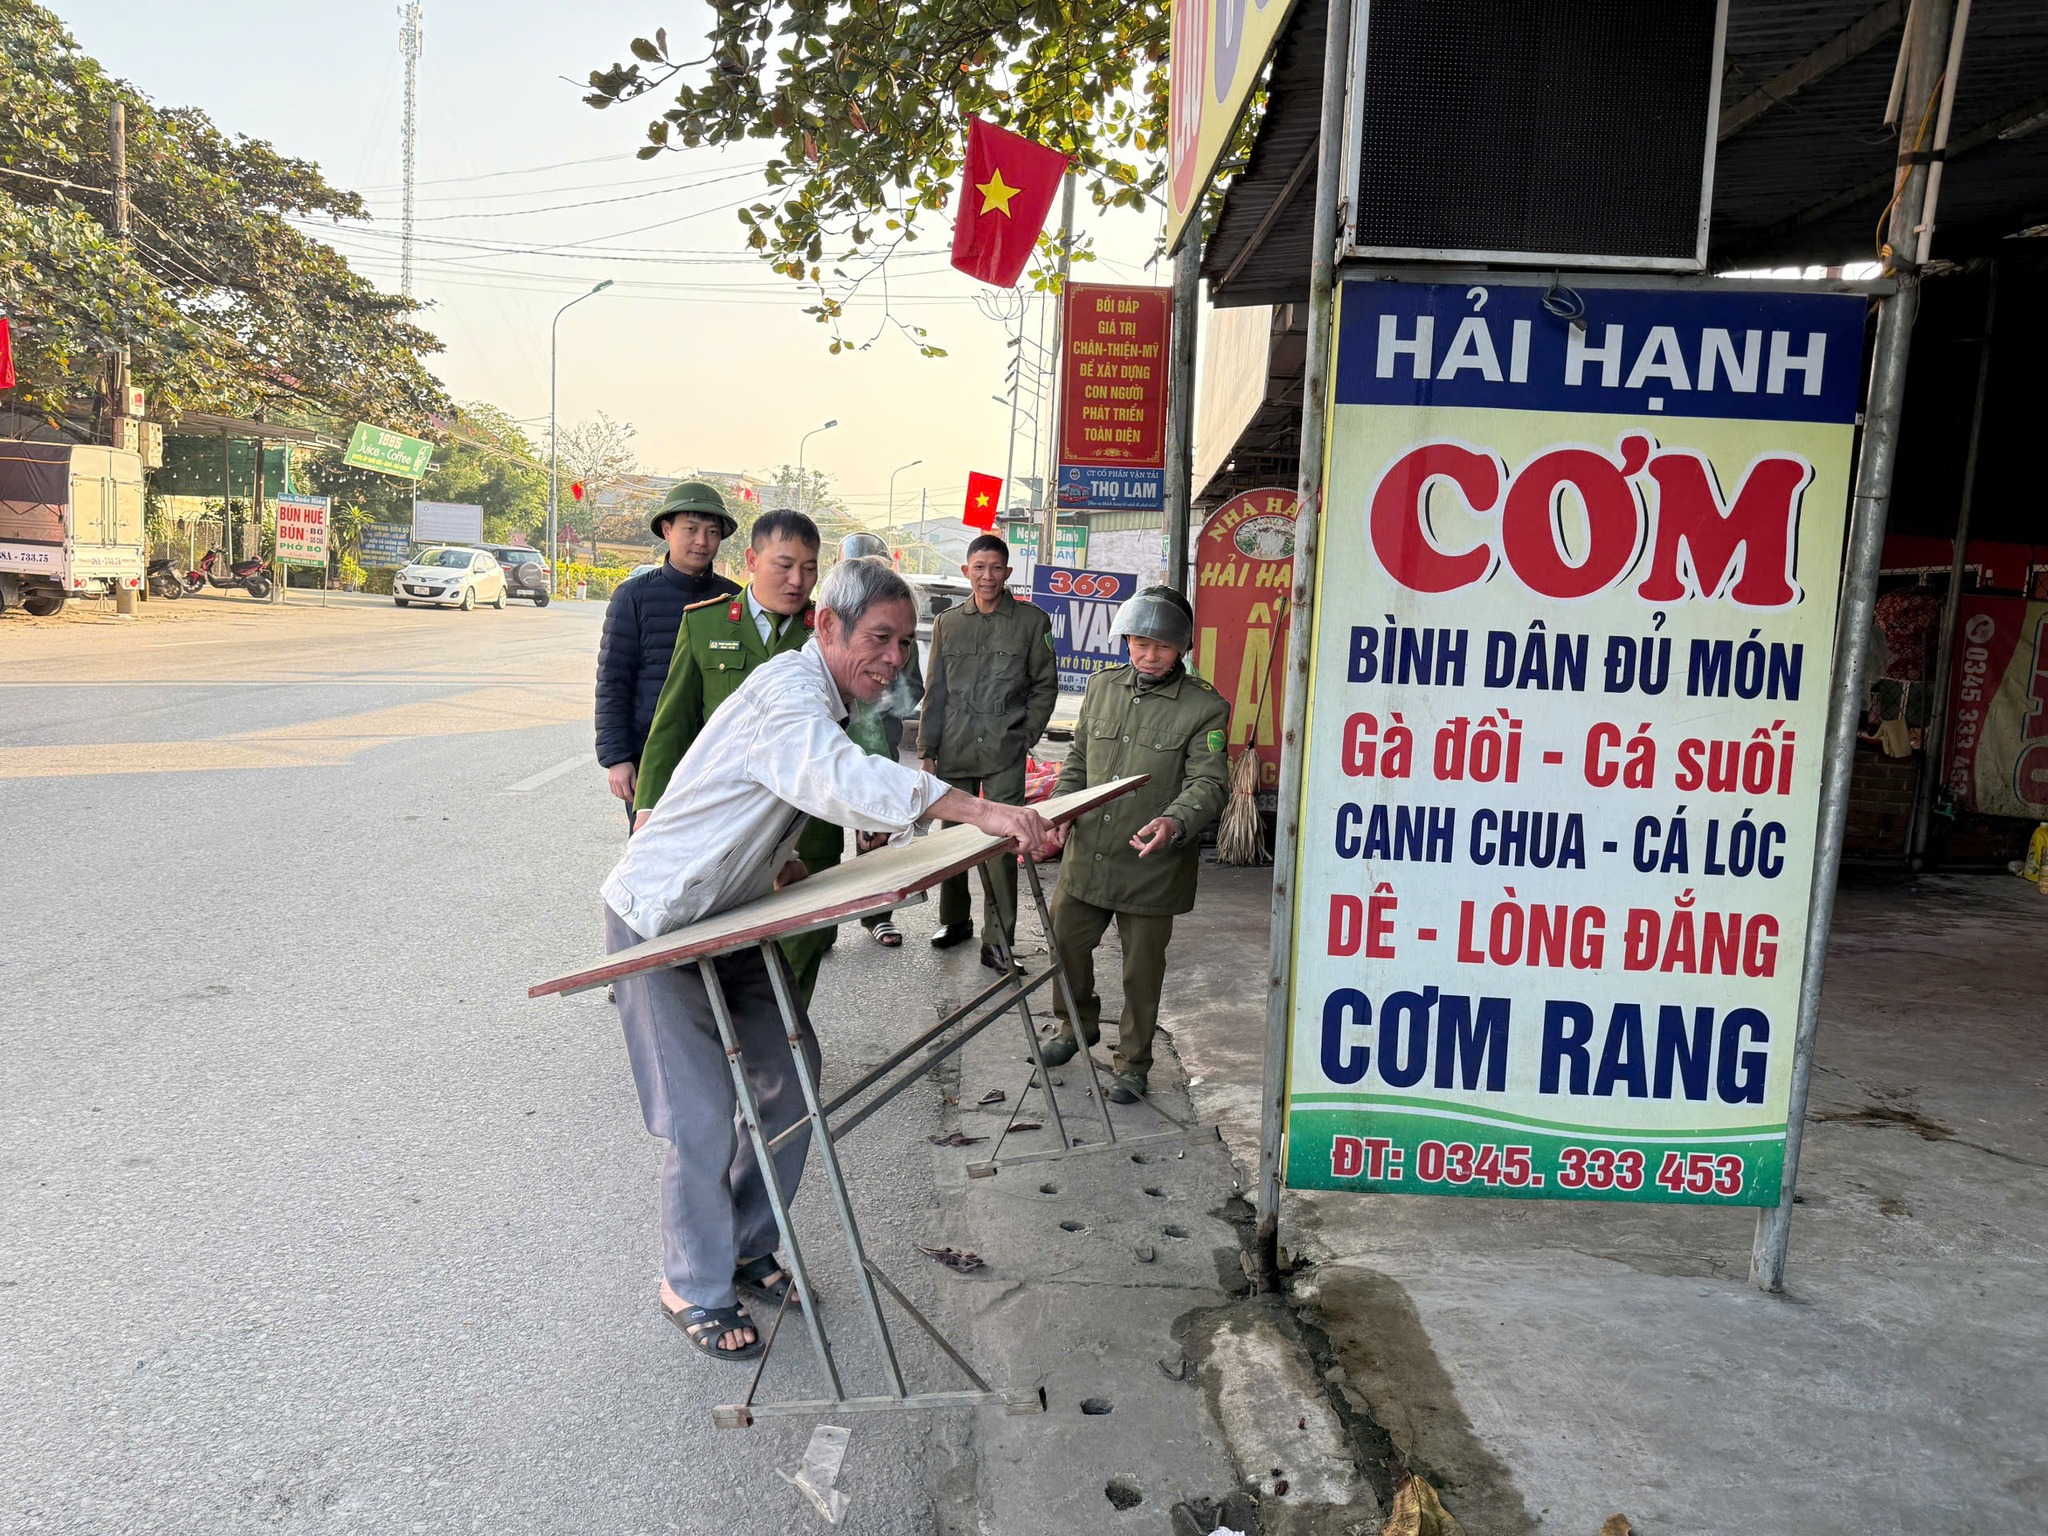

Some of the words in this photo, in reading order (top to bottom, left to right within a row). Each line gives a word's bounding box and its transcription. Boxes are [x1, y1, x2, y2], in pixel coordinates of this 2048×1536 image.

[1096, 295, 1115, 312] BỒI
[1117, 296, 1140, 314] ĐẮP
[1098, 318, 1116, 335] GIÁ
[1120, 321, 1137, 339] TRỊ
[1073, 339, 1159, 360] CHÂN-THIỆN-MỸ
[1376, 286, 1532, 384] HẢI
[1564, 320, 1828, 411] HẠNH
[1080, 358, 1095, 377] ĐỂ
[1096, 362, 1118, 378] XÂY
[1120, 364, 1151, 382] DỰNG
[1085, 385, 1108, 399] CON
[1110, 383, 1144, 400] NGƯỜI
[1082, 404, 1111, 421] PHÁT
[1113, 402, 1144, 422] TRIỂN
[1084, 425, 1112, 442] TOÀN
[1115, 427, 1141, 446] DIỆN
[356, 441, 380, 457] Juice
[387, 448, 412, 464] Coffee
[1086, 469, 1096, 477] CT
[1130, 470, 1145, 479] VẬN
[1146, 470, 1159, 479] TẢI
[1091, 480, 1120, 501] THỌ
[1124, 481, 1157, 498] LAM
[280, 504, 301, 522] BÚN
[303, 506, 325, 524] HUẾ
[1207, 497, 1260, 543] NHÀ
[1265, 497, 1298, 519] HÀ
[1368, 432, 1809, 609] CƠM
[280, 523, 304, 541] BÚN
[20, 552, 49, 562] 733.75
[1020, 546, 1037, 560] ĐẶ
[1050, 571, 1120, 598] 369
[1200, 553, 1250, 588] HẢI
[1255, 563, 1292, 594] HẠ
[1060, 655, 1072, 669] KÝ
[1092, 659, 1103, 672] XE
[1347, 614, 1469, 687] BÌNH
[1483, 619, 1590, 692] DÂN
[1604, 611, 1672, 695] ĐỦ
[1687, 628, 1804, 701] MÓN
[1199, 596, 1290, 746] LẨ
[1961, 646, 1989, 702] 0345
[1957, 708, 1980, 749] 333
[1341, 712, 1413, 779] Gà
[1433, 708, 1523, 783] đồi
[1543, 751, 1563, 765] -
[1584, 722, 1657, 789] Cá
[1675, 719, 1796, 796] suối
[1950, 754, 1971, 796] 453
[1335, 802, 1456, 864] CANH
[1469, 808, 1586, 870] CHUA
[1602, 841, 1618, 853] -
[1633, 804, 1689, 874] CÁ
[1704, 808, 1787, 879] LÓC
[1327, 881, 1398, 959] DÊ
[1417, 928, 1438, 941] -
[1457, 885, 1606, 970] LÒNG
[1623, 887, 1780, 978] ĐẮNG
[1320, 985, 1512, 1093] CƠM
[1539, 999, 1771, 1104] RANG
[1330, 1134, 1404, 1181] ĐT:
[1416, 1140, 1545, 1189] 0345.
[1557, 1146, 1645, 1190] 333
[1655, 1151, 1745, 1196] 453
